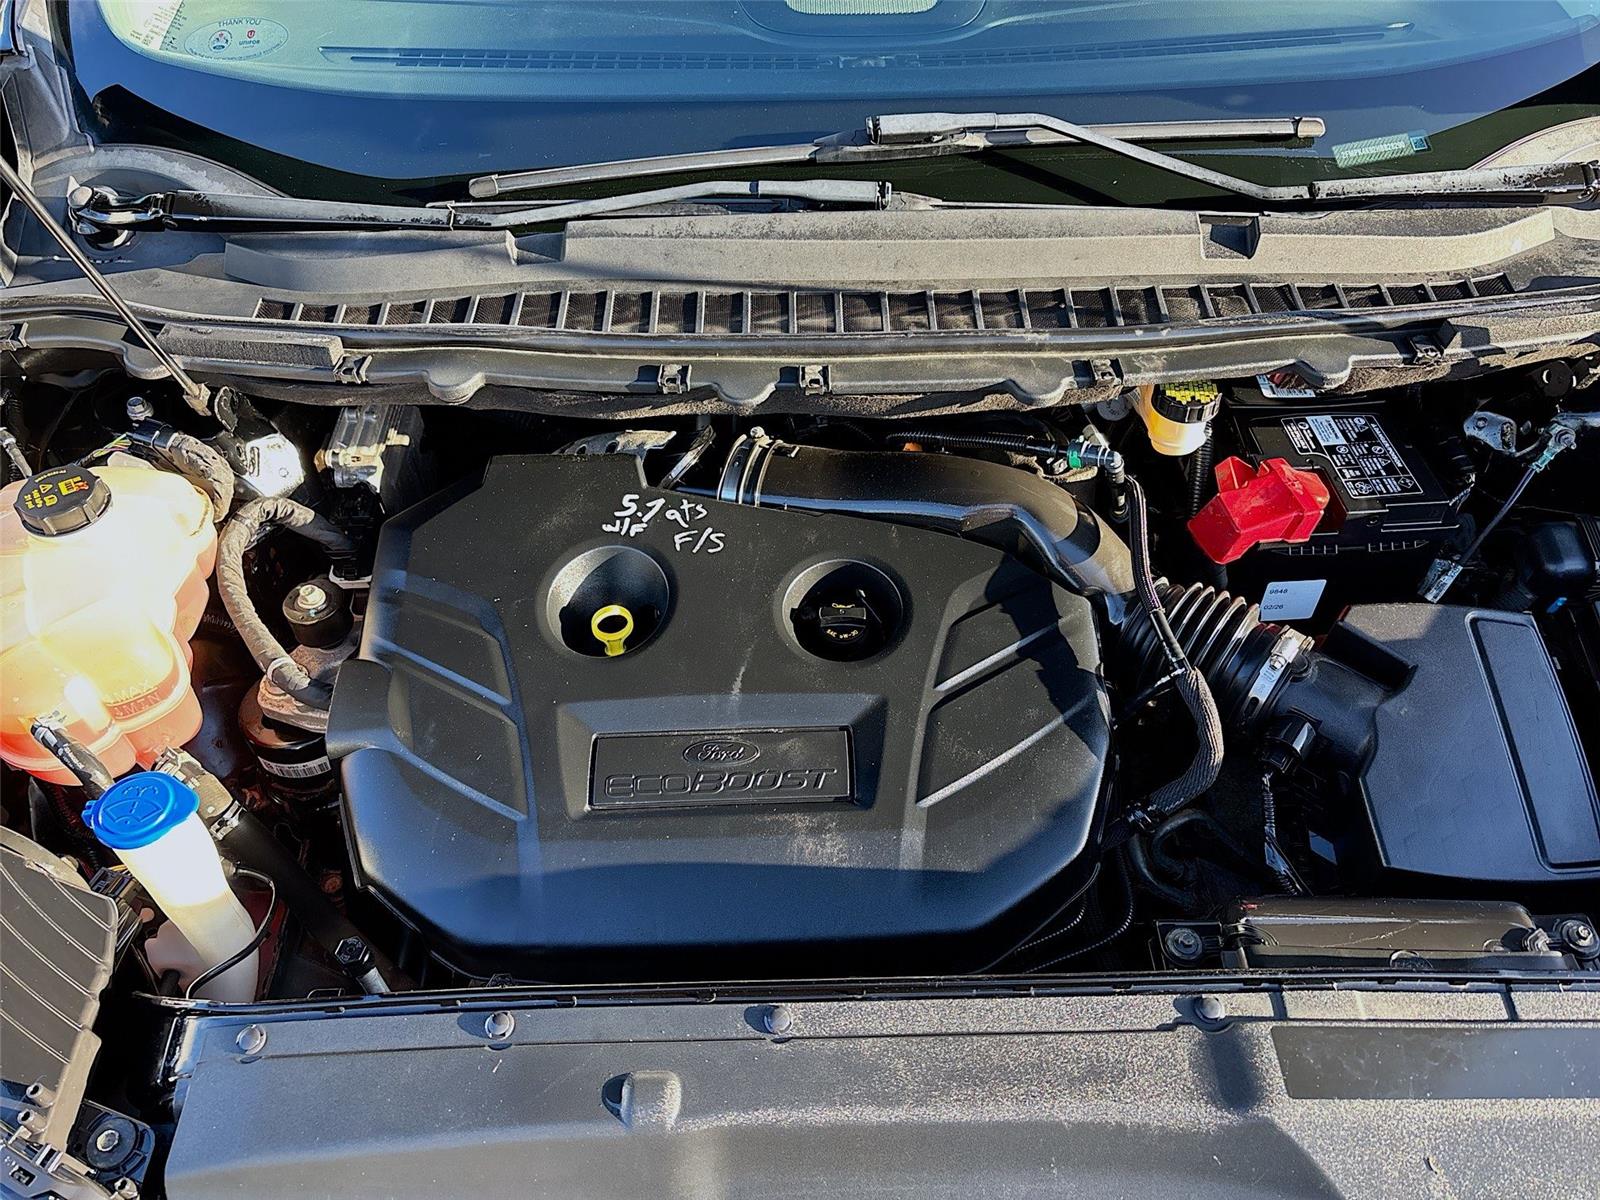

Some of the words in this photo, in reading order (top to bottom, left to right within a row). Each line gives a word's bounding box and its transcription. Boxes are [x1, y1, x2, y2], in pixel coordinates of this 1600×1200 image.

[218, 19, 243, 27] THANK
[245, 18, 261, 26] YOU
[673, 527, 726, 553] F/S
[697, 743, 744, 761] Ford
